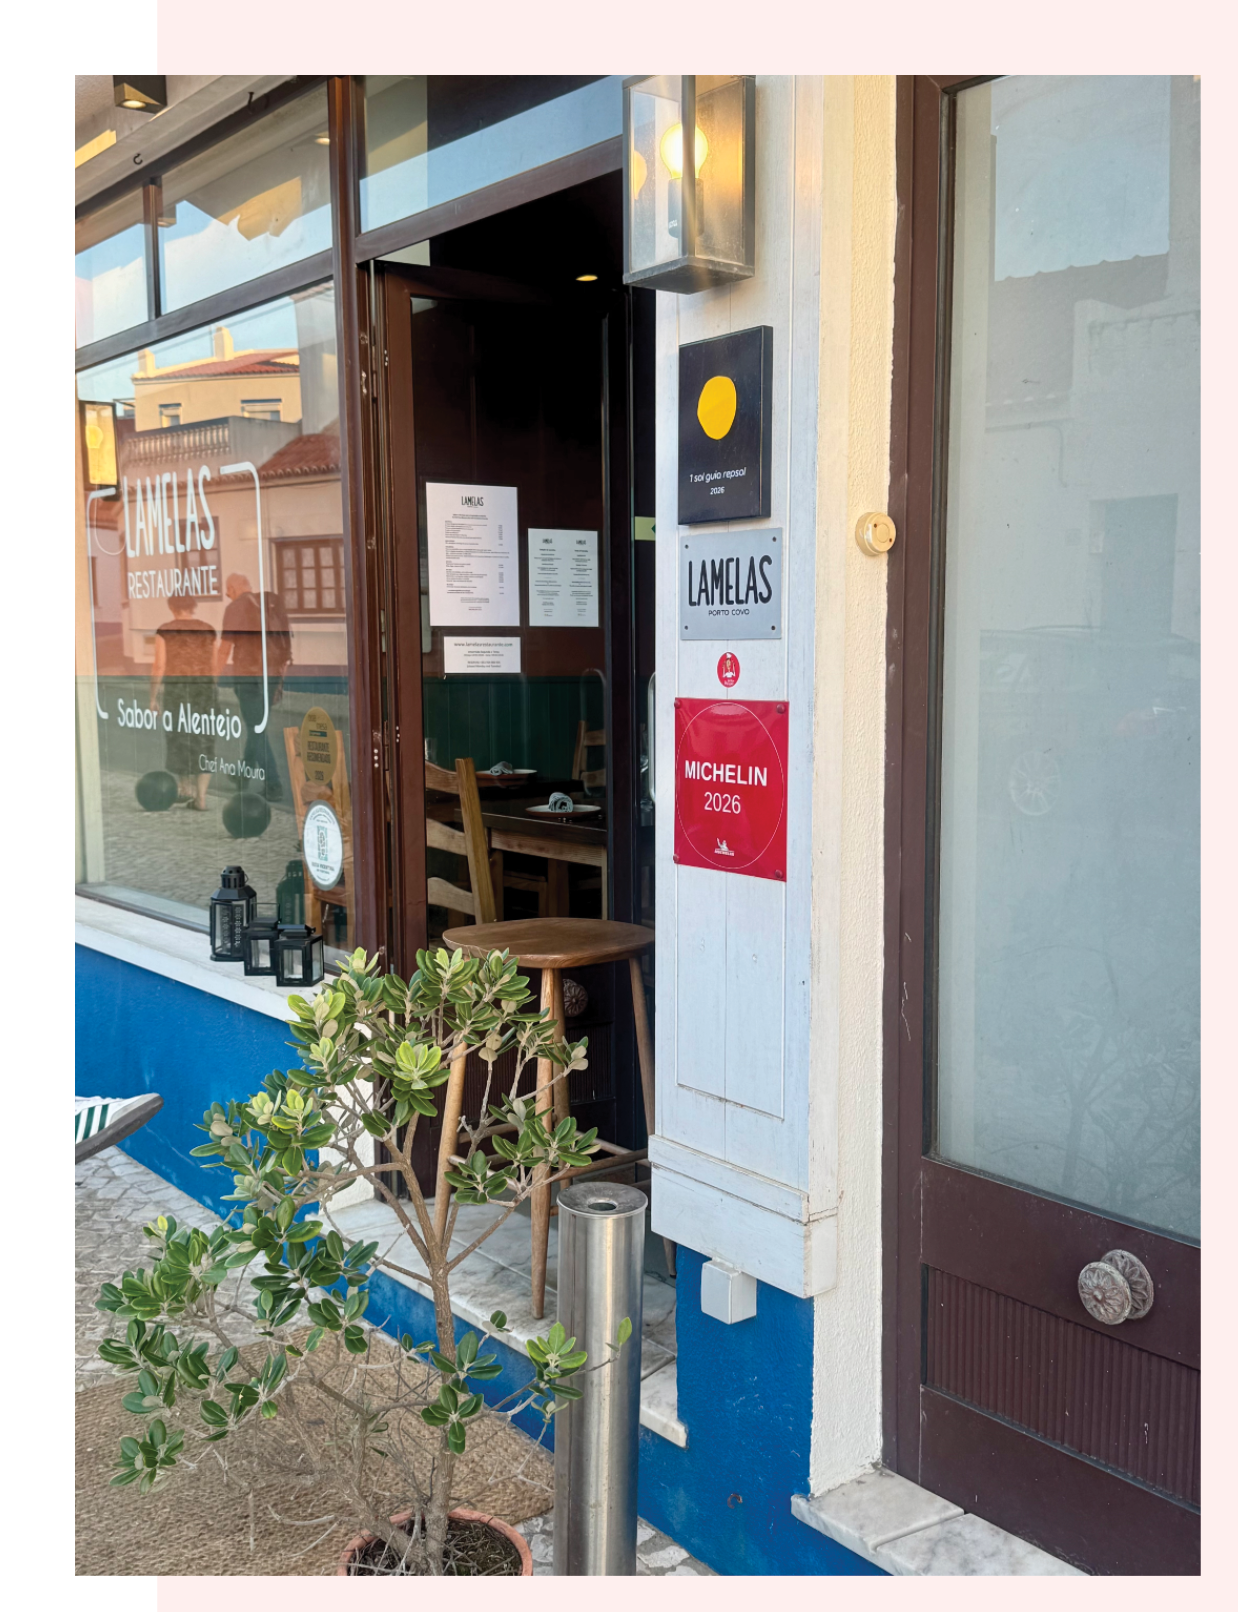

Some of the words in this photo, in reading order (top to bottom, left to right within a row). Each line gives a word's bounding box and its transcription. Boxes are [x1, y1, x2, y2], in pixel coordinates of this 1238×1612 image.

[694, 472, 705, 483] sol
[705, 470, 722, 484] guia
[723, 467, 747, 480] repsol
[123, 465, 215, 558] LAMELAS
[127, 565, 218, 600] RESTAURANTE
[688, 554, 773, 607] LAMELAS
[708, 609, 730, 617] PORTO
[731, 608, 750, 616] COVO
[117, 698, 158, 731] Sabor
[162, 710, 173, 732] a
[177, 702, 242, 741] Alentejo
[198, 753, 218, 774] Chef
[220, 758, 237, 776] Ana
[684, 760, 768, 787] MICHELIN
[704, 791, 742, 815] 2026
